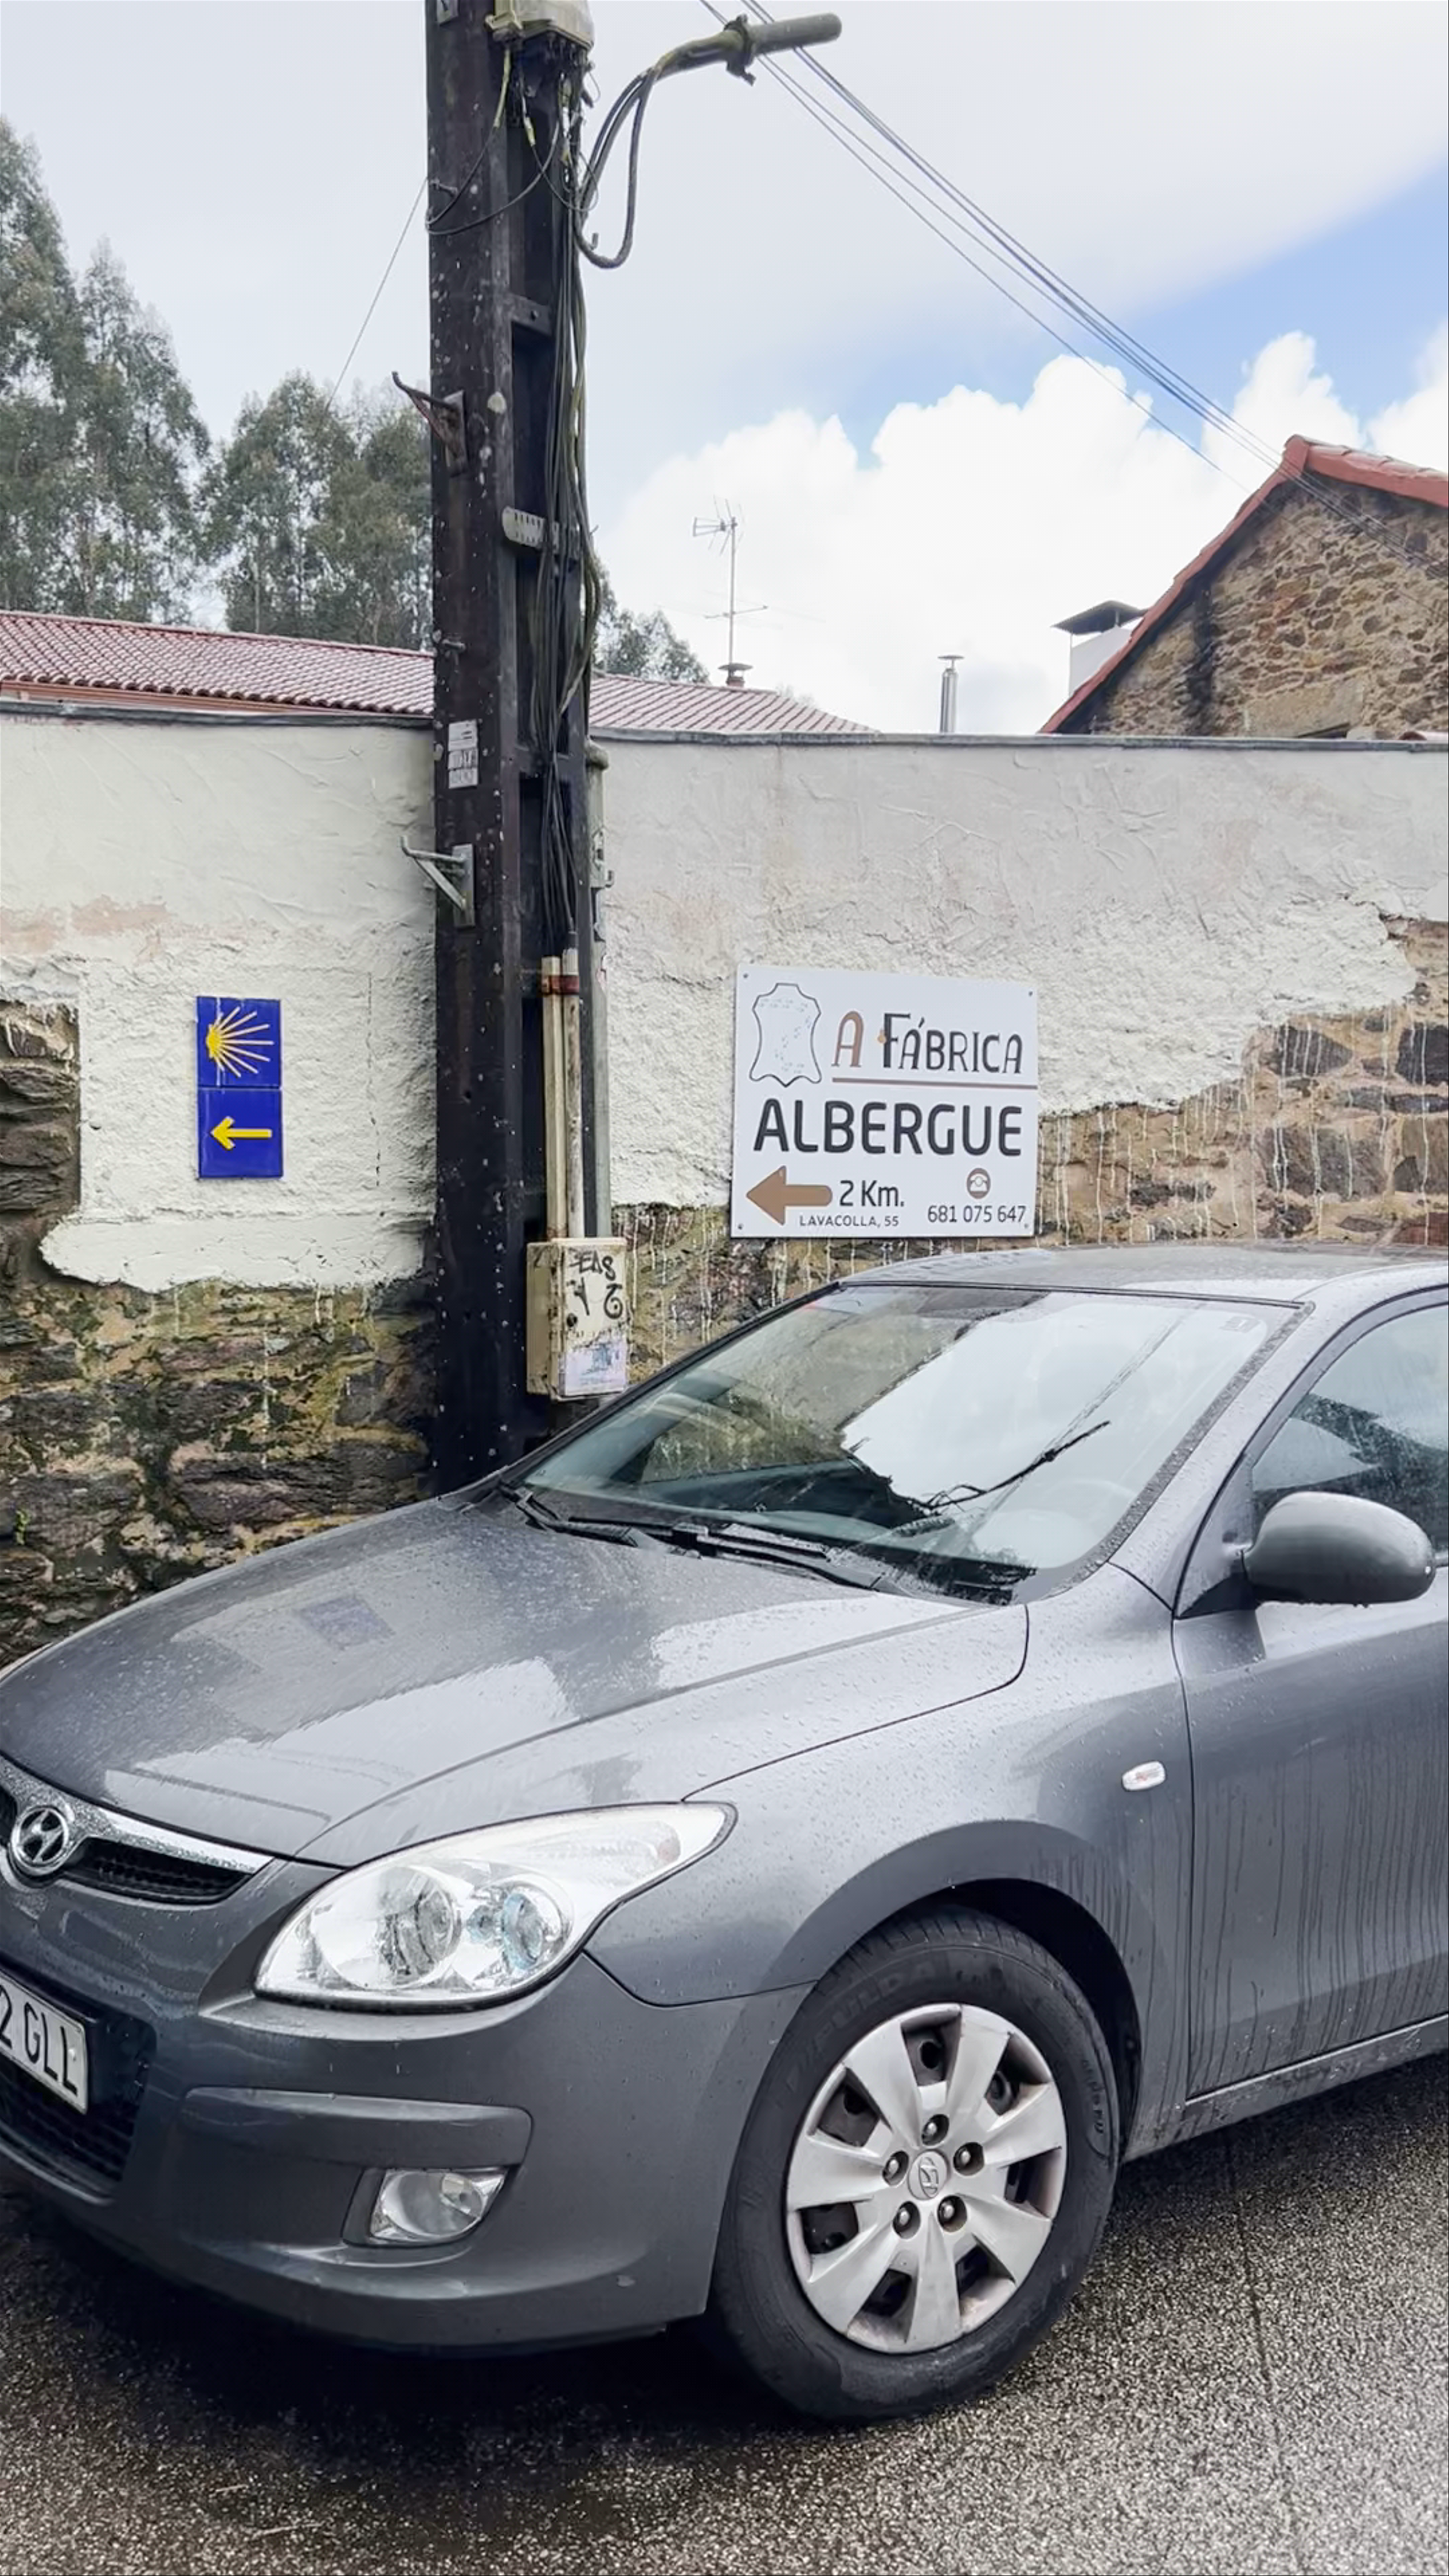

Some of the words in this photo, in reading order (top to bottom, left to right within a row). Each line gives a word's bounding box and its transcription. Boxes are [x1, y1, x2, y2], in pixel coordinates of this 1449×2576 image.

[831, 1010, 864, 1068] A
[883, 1012, 1023, 1074] FÁBRICA
[753, 1098, 1022, 1157] ALBERGUE
[839, 1180, 854, 1207] 2
[861, 1180, 904, 1207] Km.
[927, 1205, 958, 1223] 681
[963, 1205, 992, 1223] 075
[997, 1205, 1026, 1223] 647
[799, 1214, 880, 1228] LAVACOLLA,
[884, 1215, 899, 1227] 55
[24, 2001, 78, 2097] GLL
